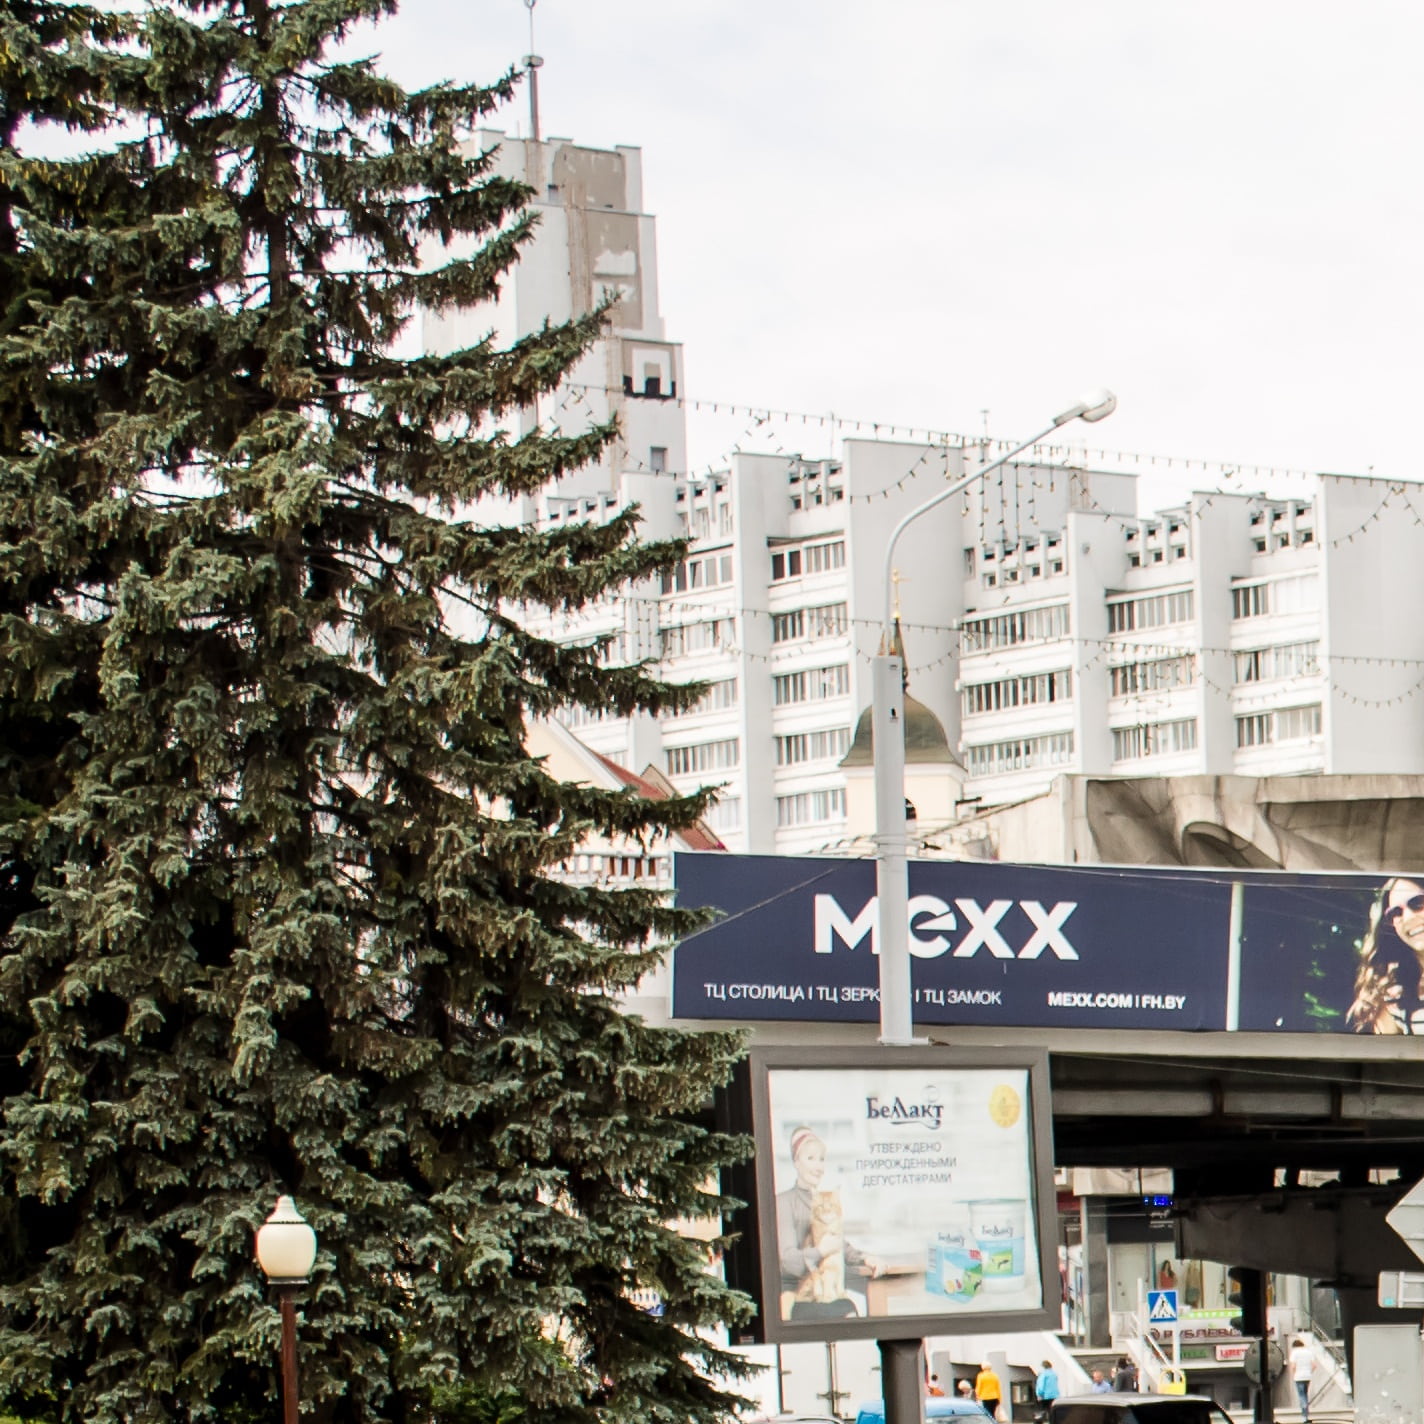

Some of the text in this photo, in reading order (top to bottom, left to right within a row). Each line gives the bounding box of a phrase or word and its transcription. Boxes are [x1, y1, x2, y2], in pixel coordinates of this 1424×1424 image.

[704, 983, 728, 1001] ТЦ
[728, 984, 806, 1002] СТОЛИЦА
[816, 986, 839, 1003] ТЦ
[924, 989, 945, 1005] ТЦ
[947, 990, 1001, 1005] ЗАМОК
[1048, 991, 1132, 1009] MEXX.COM
[1141, 995, 1185, 1010] FH.BY
[869, 1141, 942, 1156] УТВЕРЖДЕНО
[855, 1157, 957, 1172] ПРИРОЖДЕННЫМИ
